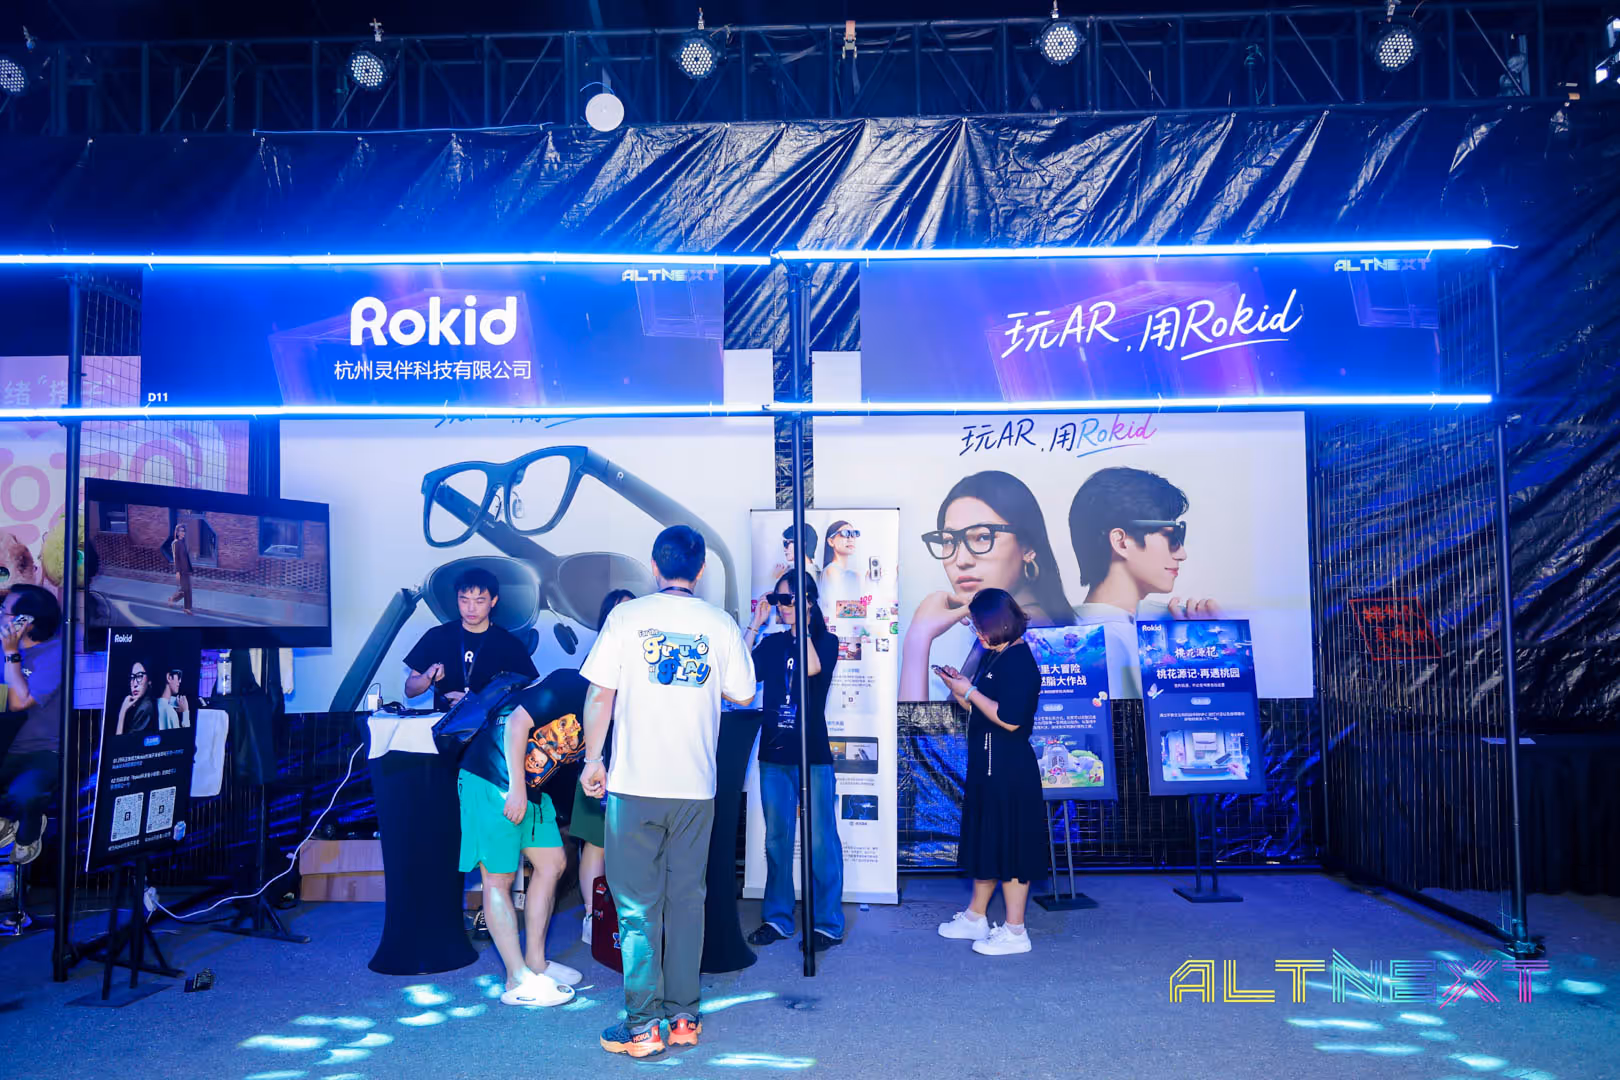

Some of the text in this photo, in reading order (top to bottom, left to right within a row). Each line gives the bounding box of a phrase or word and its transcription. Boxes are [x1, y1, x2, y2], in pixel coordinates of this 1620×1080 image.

[622, 268, 718, 282] ALTNEXT
[351, 294, 518, 346] Rokid
[334, 359, 532, 381] 杭州灵伴科技有限公司
[147, 392, 169, 402] D11
[1142, 624, 1162, 633] Rokid
[114, 633, 133, 644] Rokid
[1037, 663, 1081, 675] 里大冒险
[1156, 667, 1240, 681] 桃花源记·再遇桃园
[633, 1032, 650, 1044] HOKA
